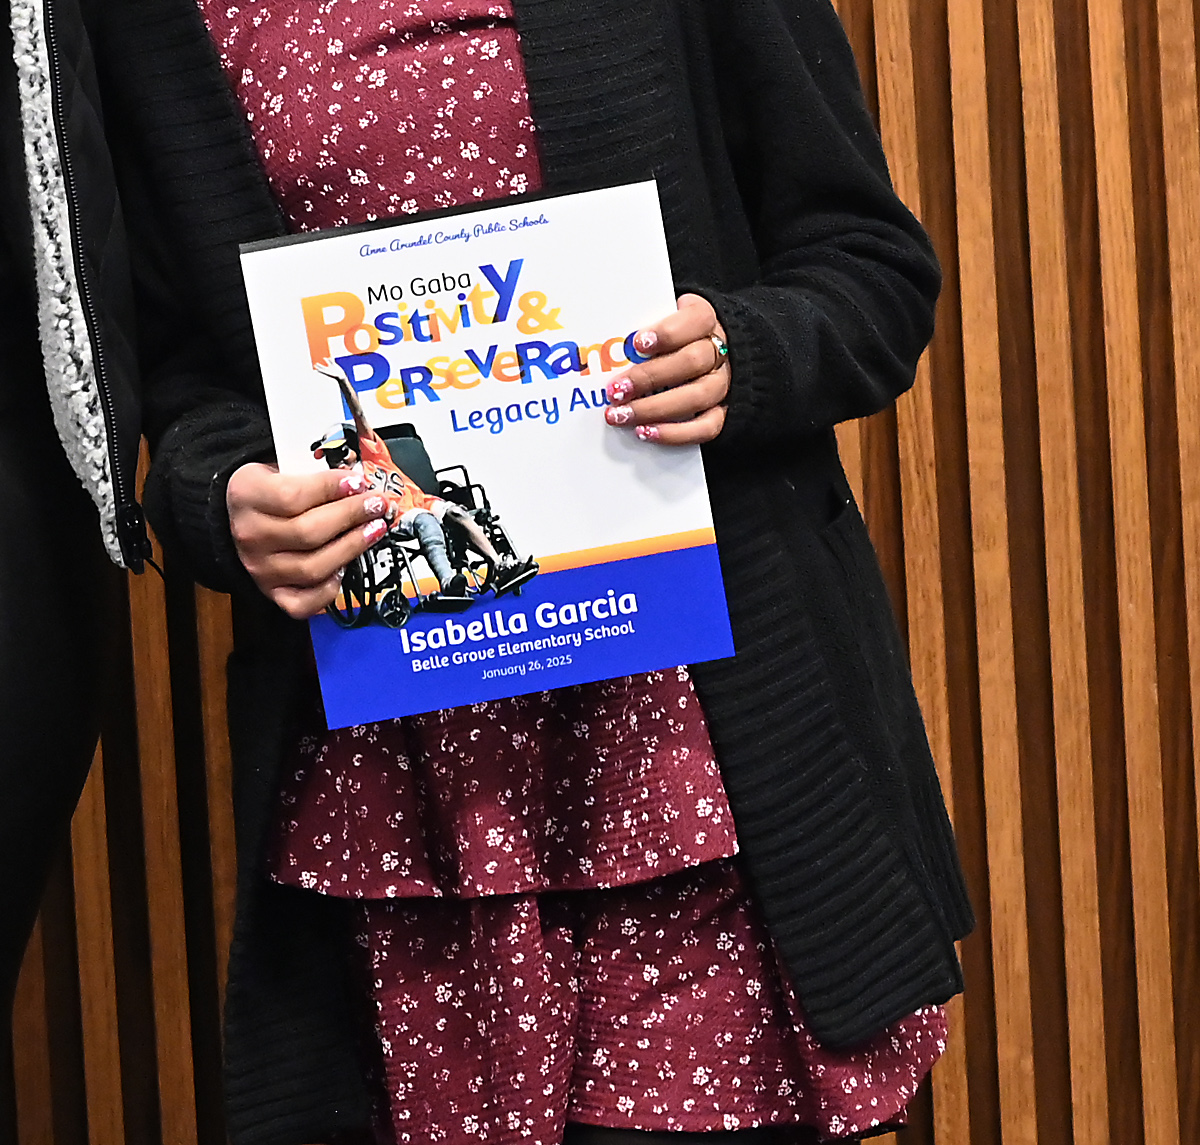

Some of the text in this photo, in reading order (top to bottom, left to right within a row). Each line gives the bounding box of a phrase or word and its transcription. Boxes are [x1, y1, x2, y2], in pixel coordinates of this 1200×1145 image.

[359, 214, 549, 257] Anne Arundel County Public Schools
[367, 272, 472, 305] Mo Gaba
[516, 290, 565, 335] &
[450, 395, 560, 435] Legacy
[400, 589, 639, 654] Isabella Garcia
[411, 620, 636, 673] Belle Grove Elementary School
[481, 654, 573, 680] January 26, 2025
